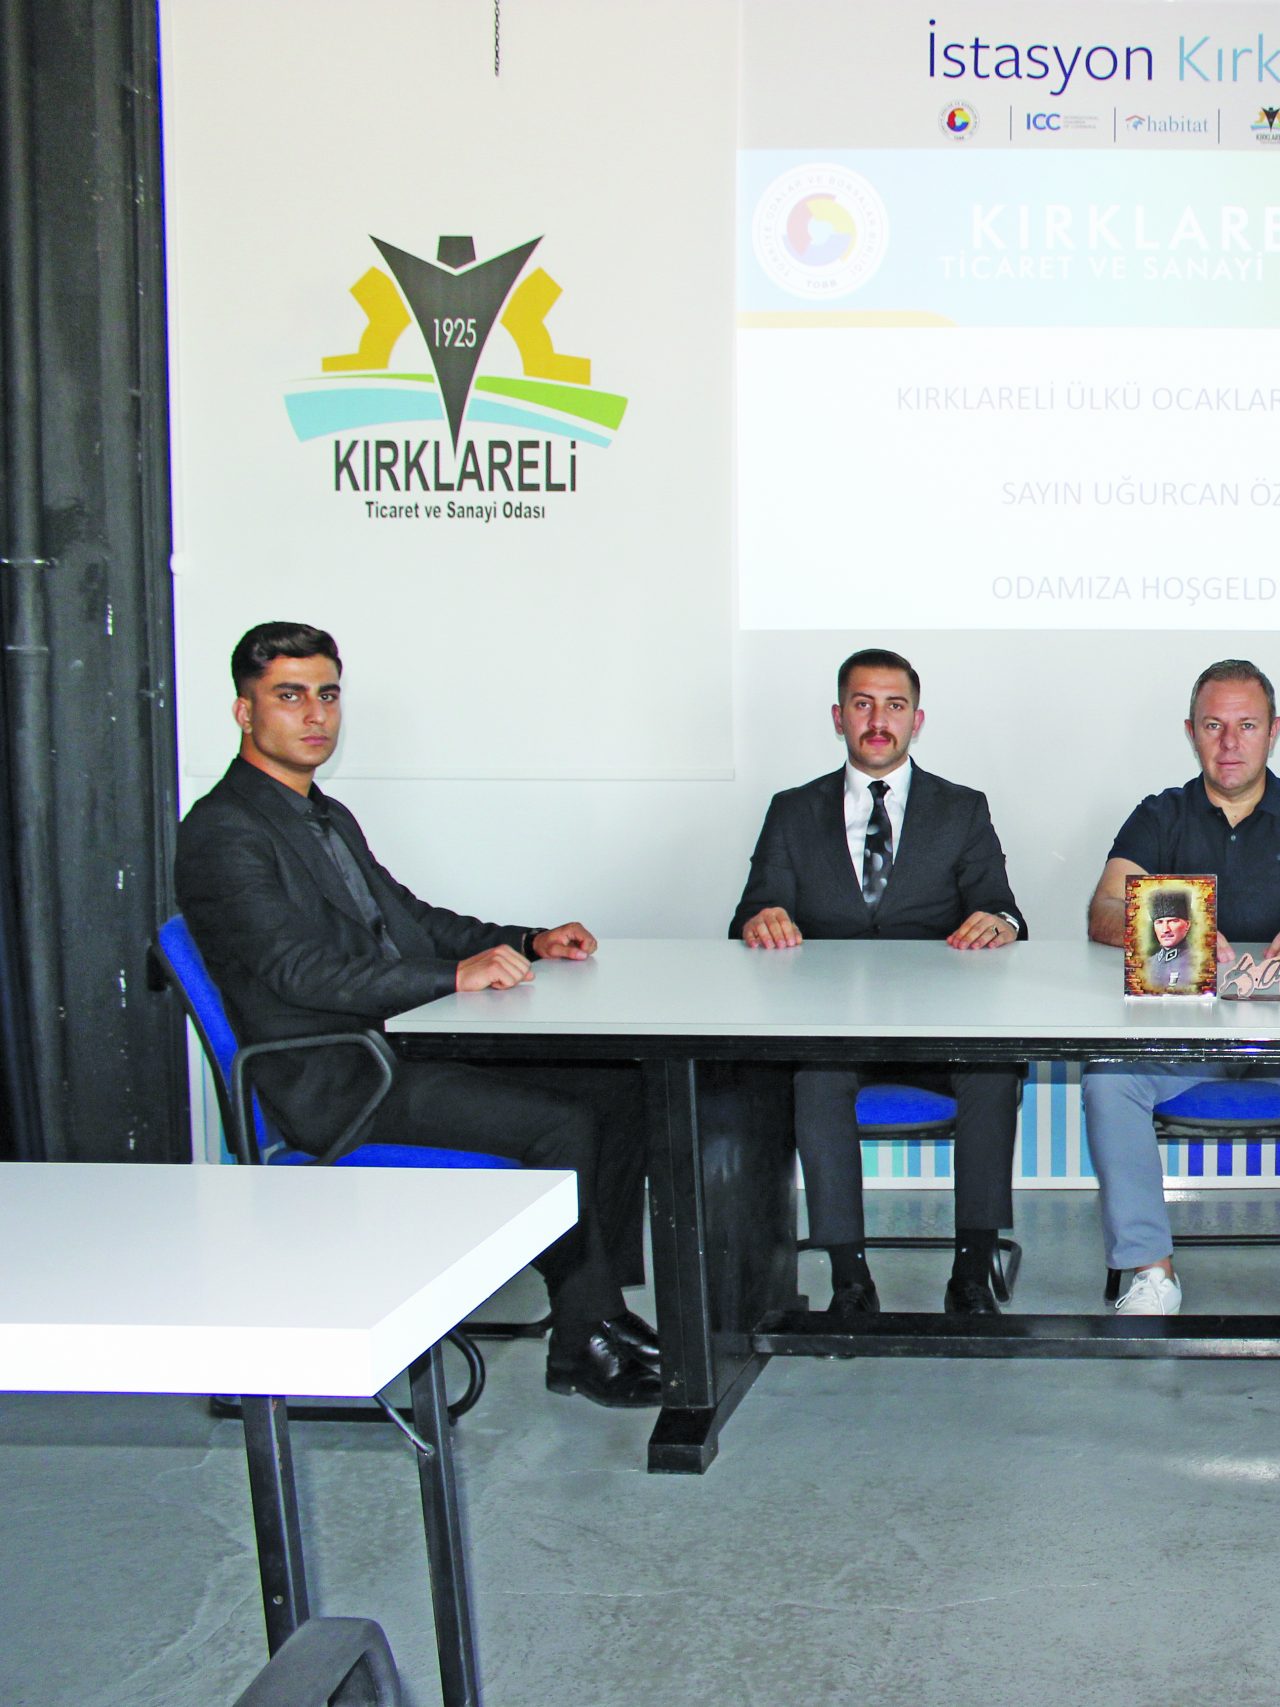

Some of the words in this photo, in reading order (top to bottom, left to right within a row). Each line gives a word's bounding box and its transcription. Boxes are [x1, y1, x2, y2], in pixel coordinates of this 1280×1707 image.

[928, 19, 1153, 97] İstasyon
[1026, 113, 1061, 131] ICC
[1146, 115, 1208, 133] habitat
[938, 250, 1073, 280] TİCARET
[1088, 255, 1127, 280] VE
[1143, 251, 1265, 281] SANAYİ
[433, 317, 477, 348] 1925
[896, 381, 1054, 411] KIRKLARELİ
[1065, 380, 1142, 412] ÜLKÜ
[1001, 481, 1082, 506] SAYIN
[1093, 475, 1240, 507] UĞURCAN
[365, 501, 420, 519] Ticaret
[424, 505, 442, 519] ve
[446, 501, 498, 523] Sanayi
[502, 501, 546, 520] Odası
[991, 575, 1132, 601] ODAMIZA
